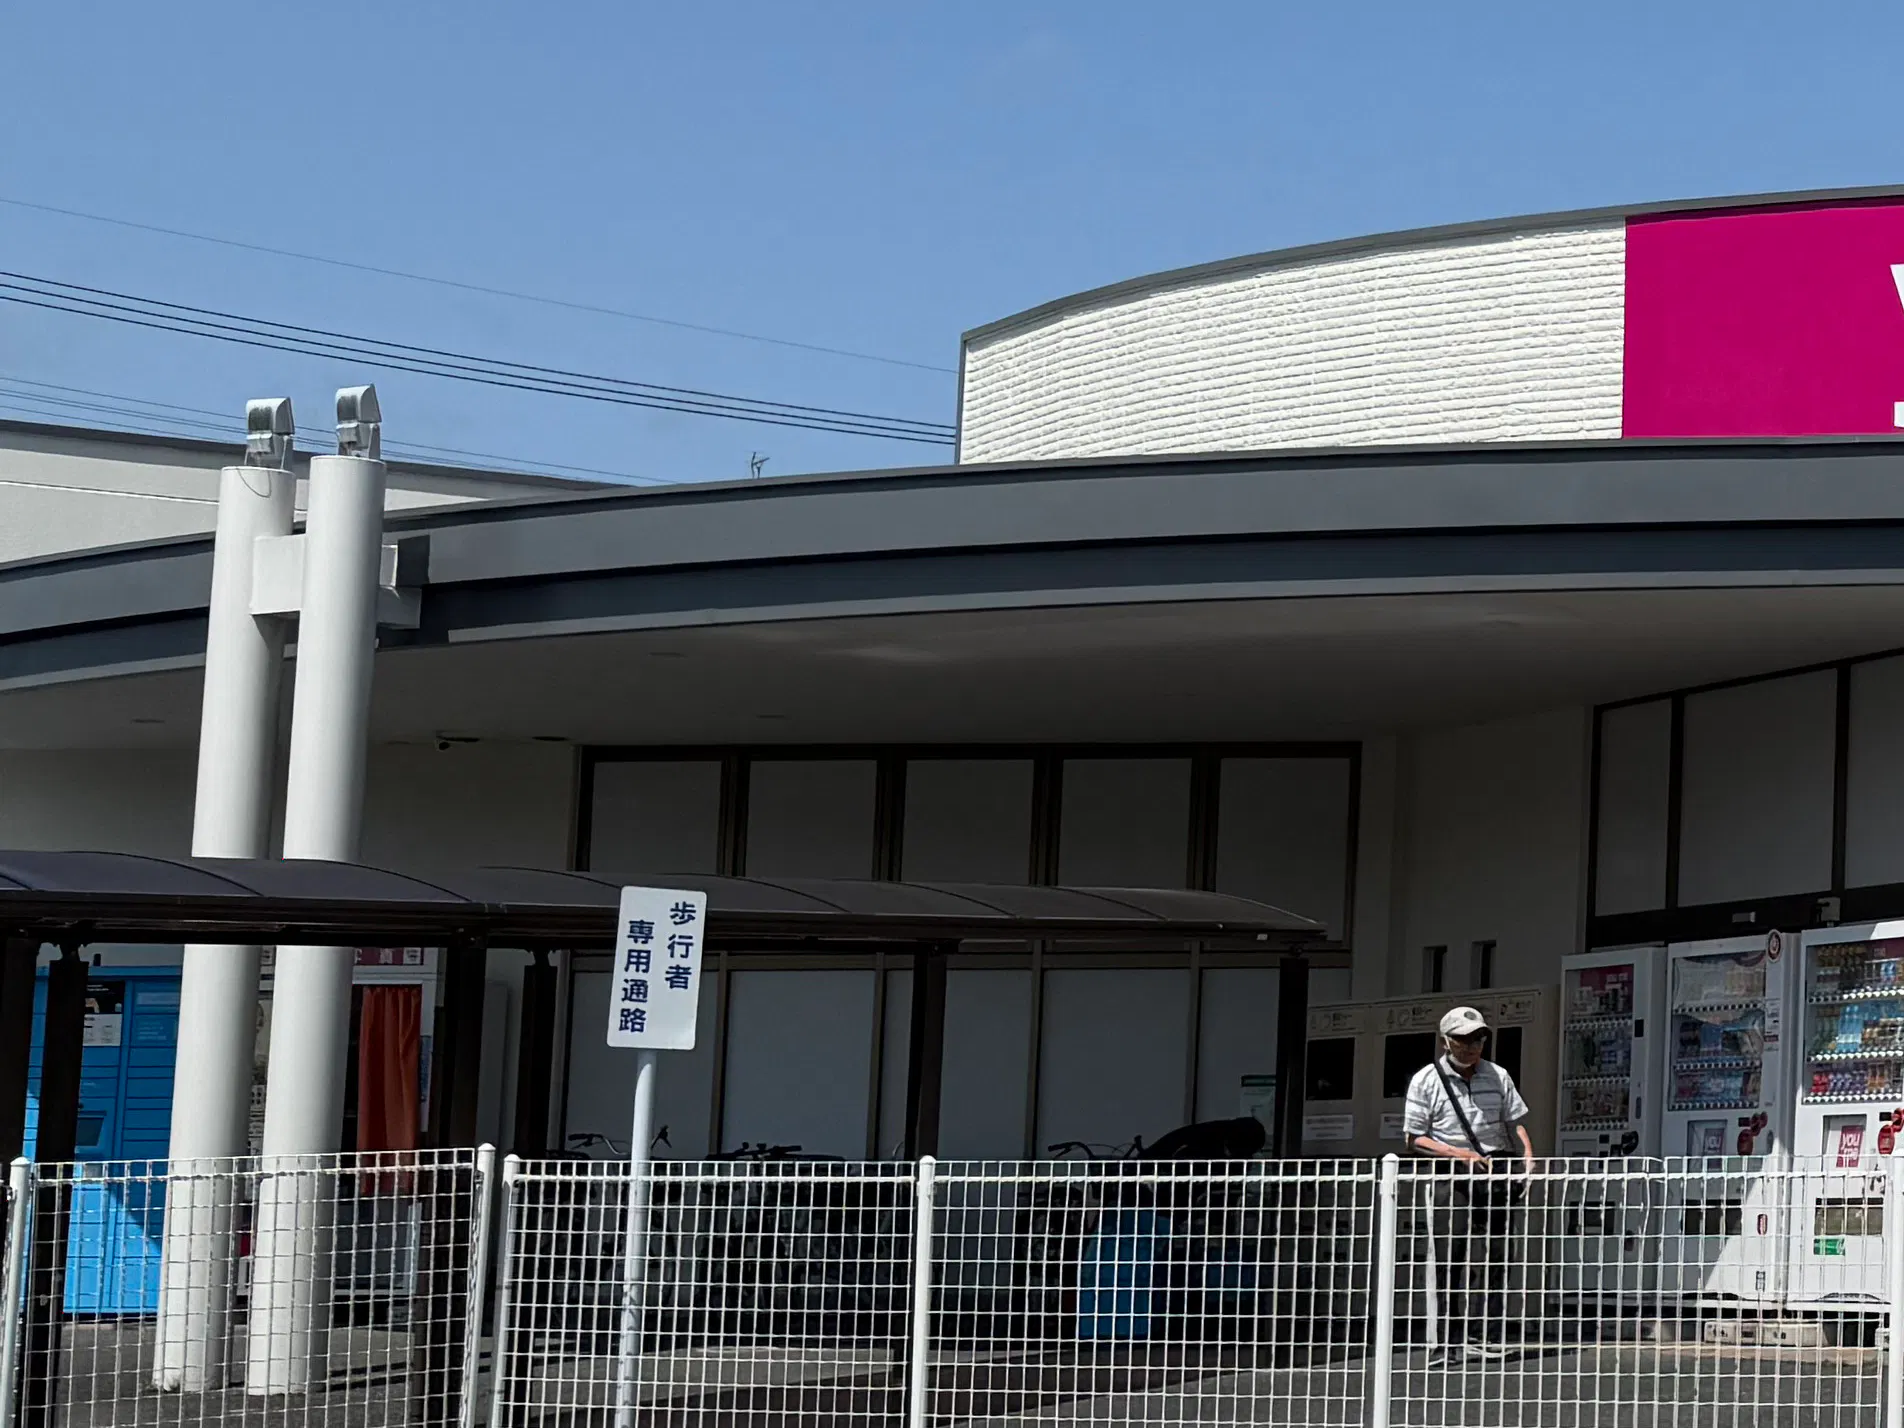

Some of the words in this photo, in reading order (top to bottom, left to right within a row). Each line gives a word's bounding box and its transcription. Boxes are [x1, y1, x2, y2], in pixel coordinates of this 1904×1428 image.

[619, 920, 655, 1033] 専用通路
[665, 901, 697, 990] 歩行者
